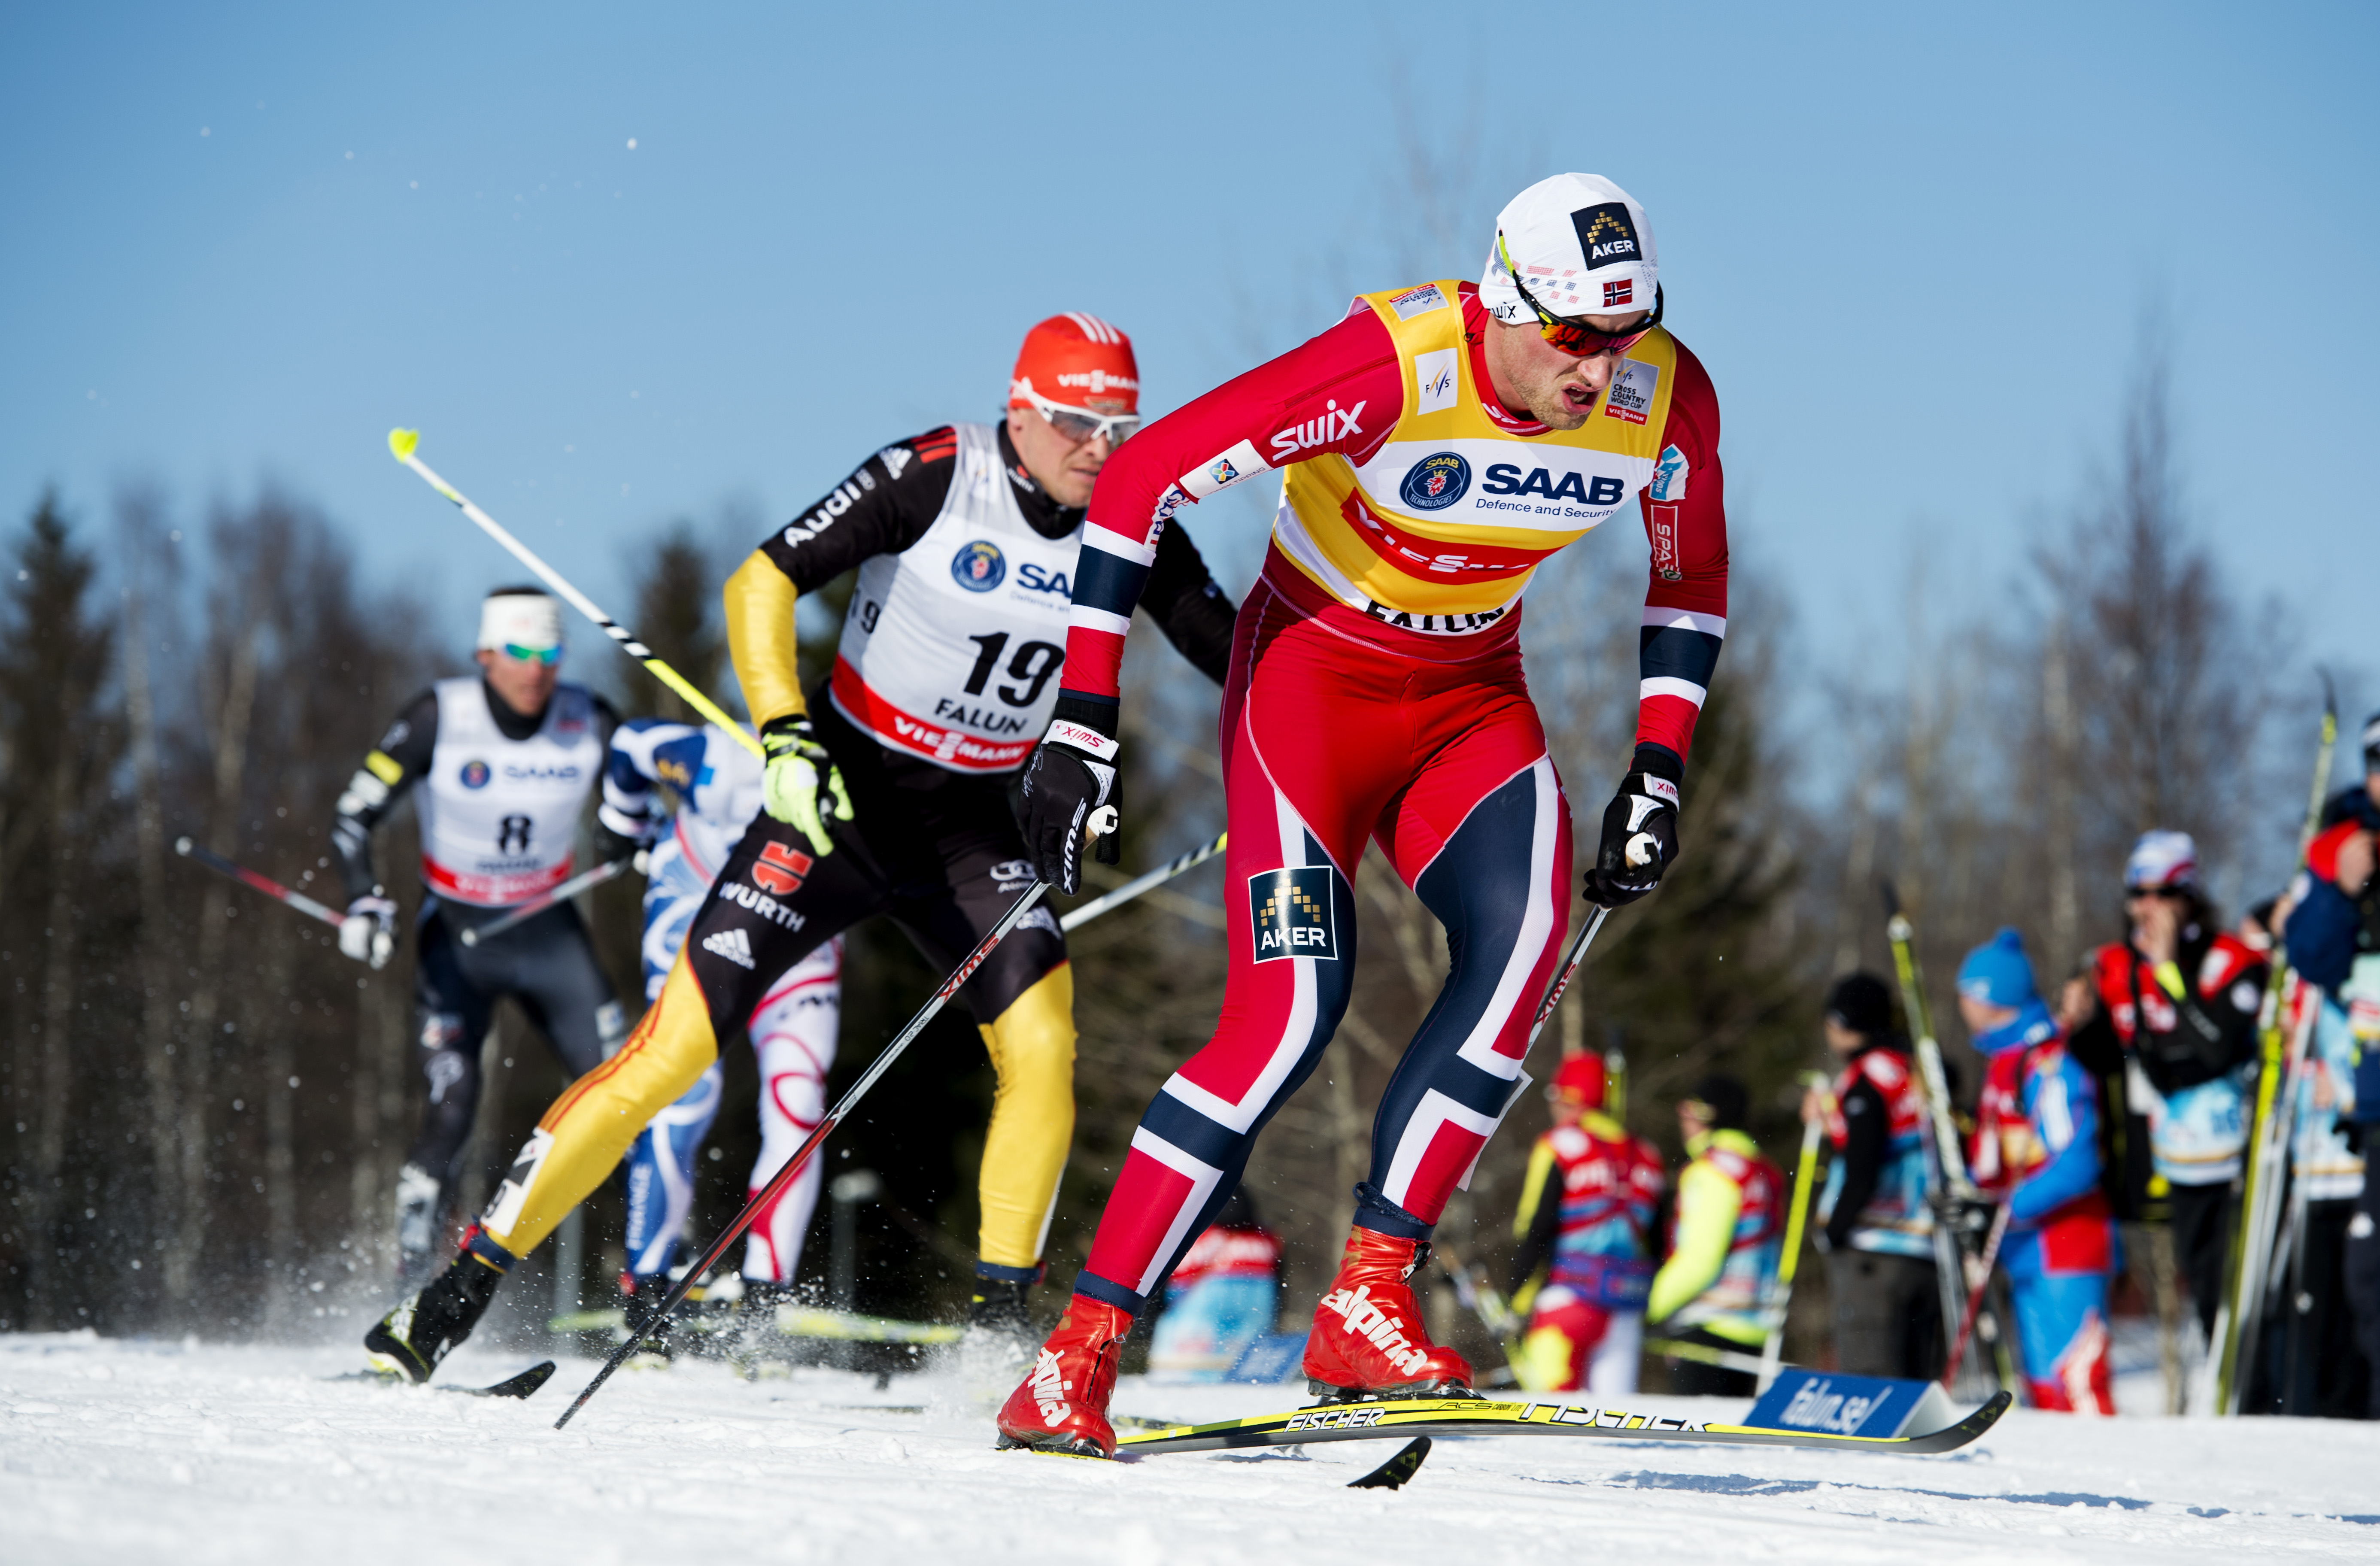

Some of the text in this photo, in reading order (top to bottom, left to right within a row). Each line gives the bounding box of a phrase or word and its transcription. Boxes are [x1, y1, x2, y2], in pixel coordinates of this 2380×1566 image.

[1591, 239, 1635, 260] AKER
[1486, 301, 1517, 319] wix
[1612, 390, 1647, 405] COUNTRY
[1613, 383, 1637, 395] CROSS
[1424, 457, 1460, 469] SAAB
[1233, 467, 1266, 484] TIPPING
[1482, 463, 1625, 506] SAAB
[1409, 493, 1454, 507] TECHNOLOGIES
[1475, 498, 1617, 519] Defence and Security
[1016, 563, 1072, 599] SA
[1058, 604, 1070, 613] an
[962, 631, 1066, 708] 19
[935, 696, 1028, 736] FALUN
[1261, 927, 1327, 951] AKER
[1321, 1284, 1428, 1377] alpina
[1284, 1407, 1386, 1433] FISCHER
